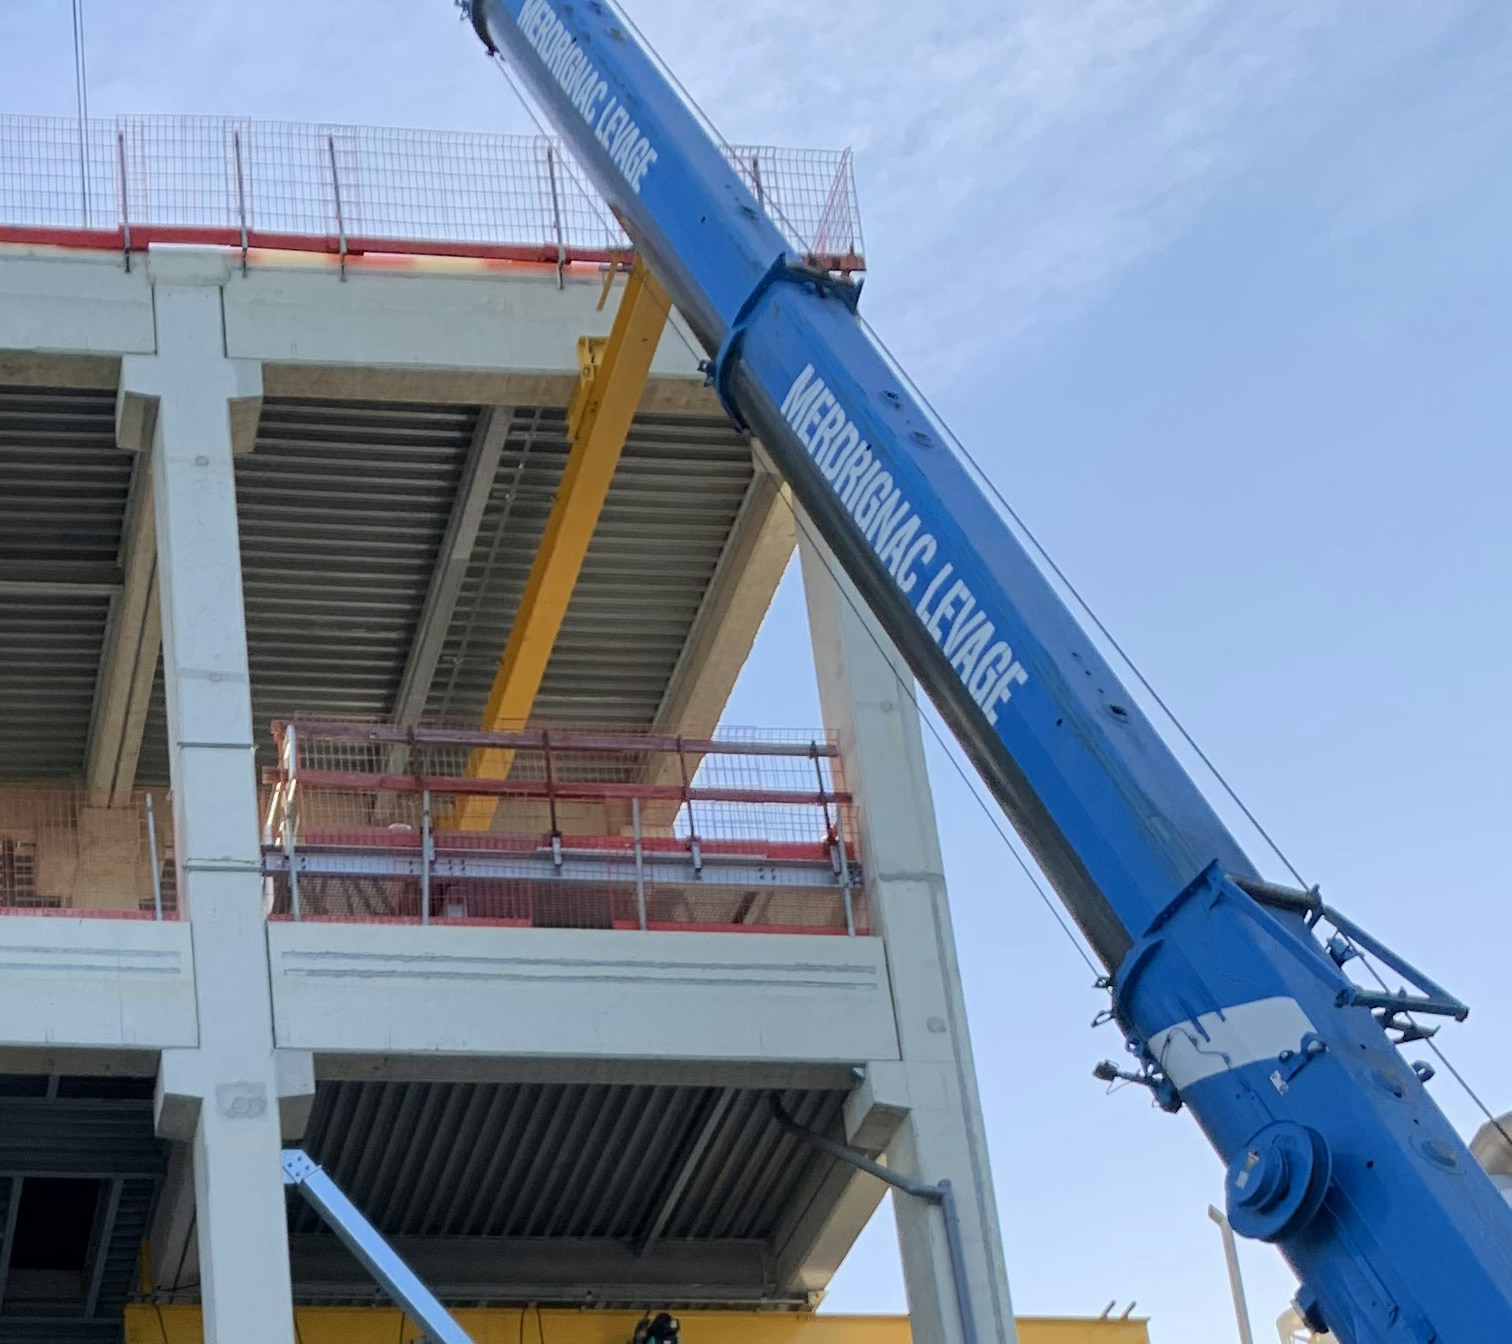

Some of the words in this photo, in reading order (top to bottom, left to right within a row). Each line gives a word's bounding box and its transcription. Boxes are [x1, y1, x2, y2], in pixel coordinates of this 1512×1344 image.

[517, 0, 608, 124] MERDRIGNAC
[594, 96, 658, 194] LEVAGE
[780, 363, 938, 594] MERDRIGNAC
[916, 563, 1029, 726] LEVAGE
